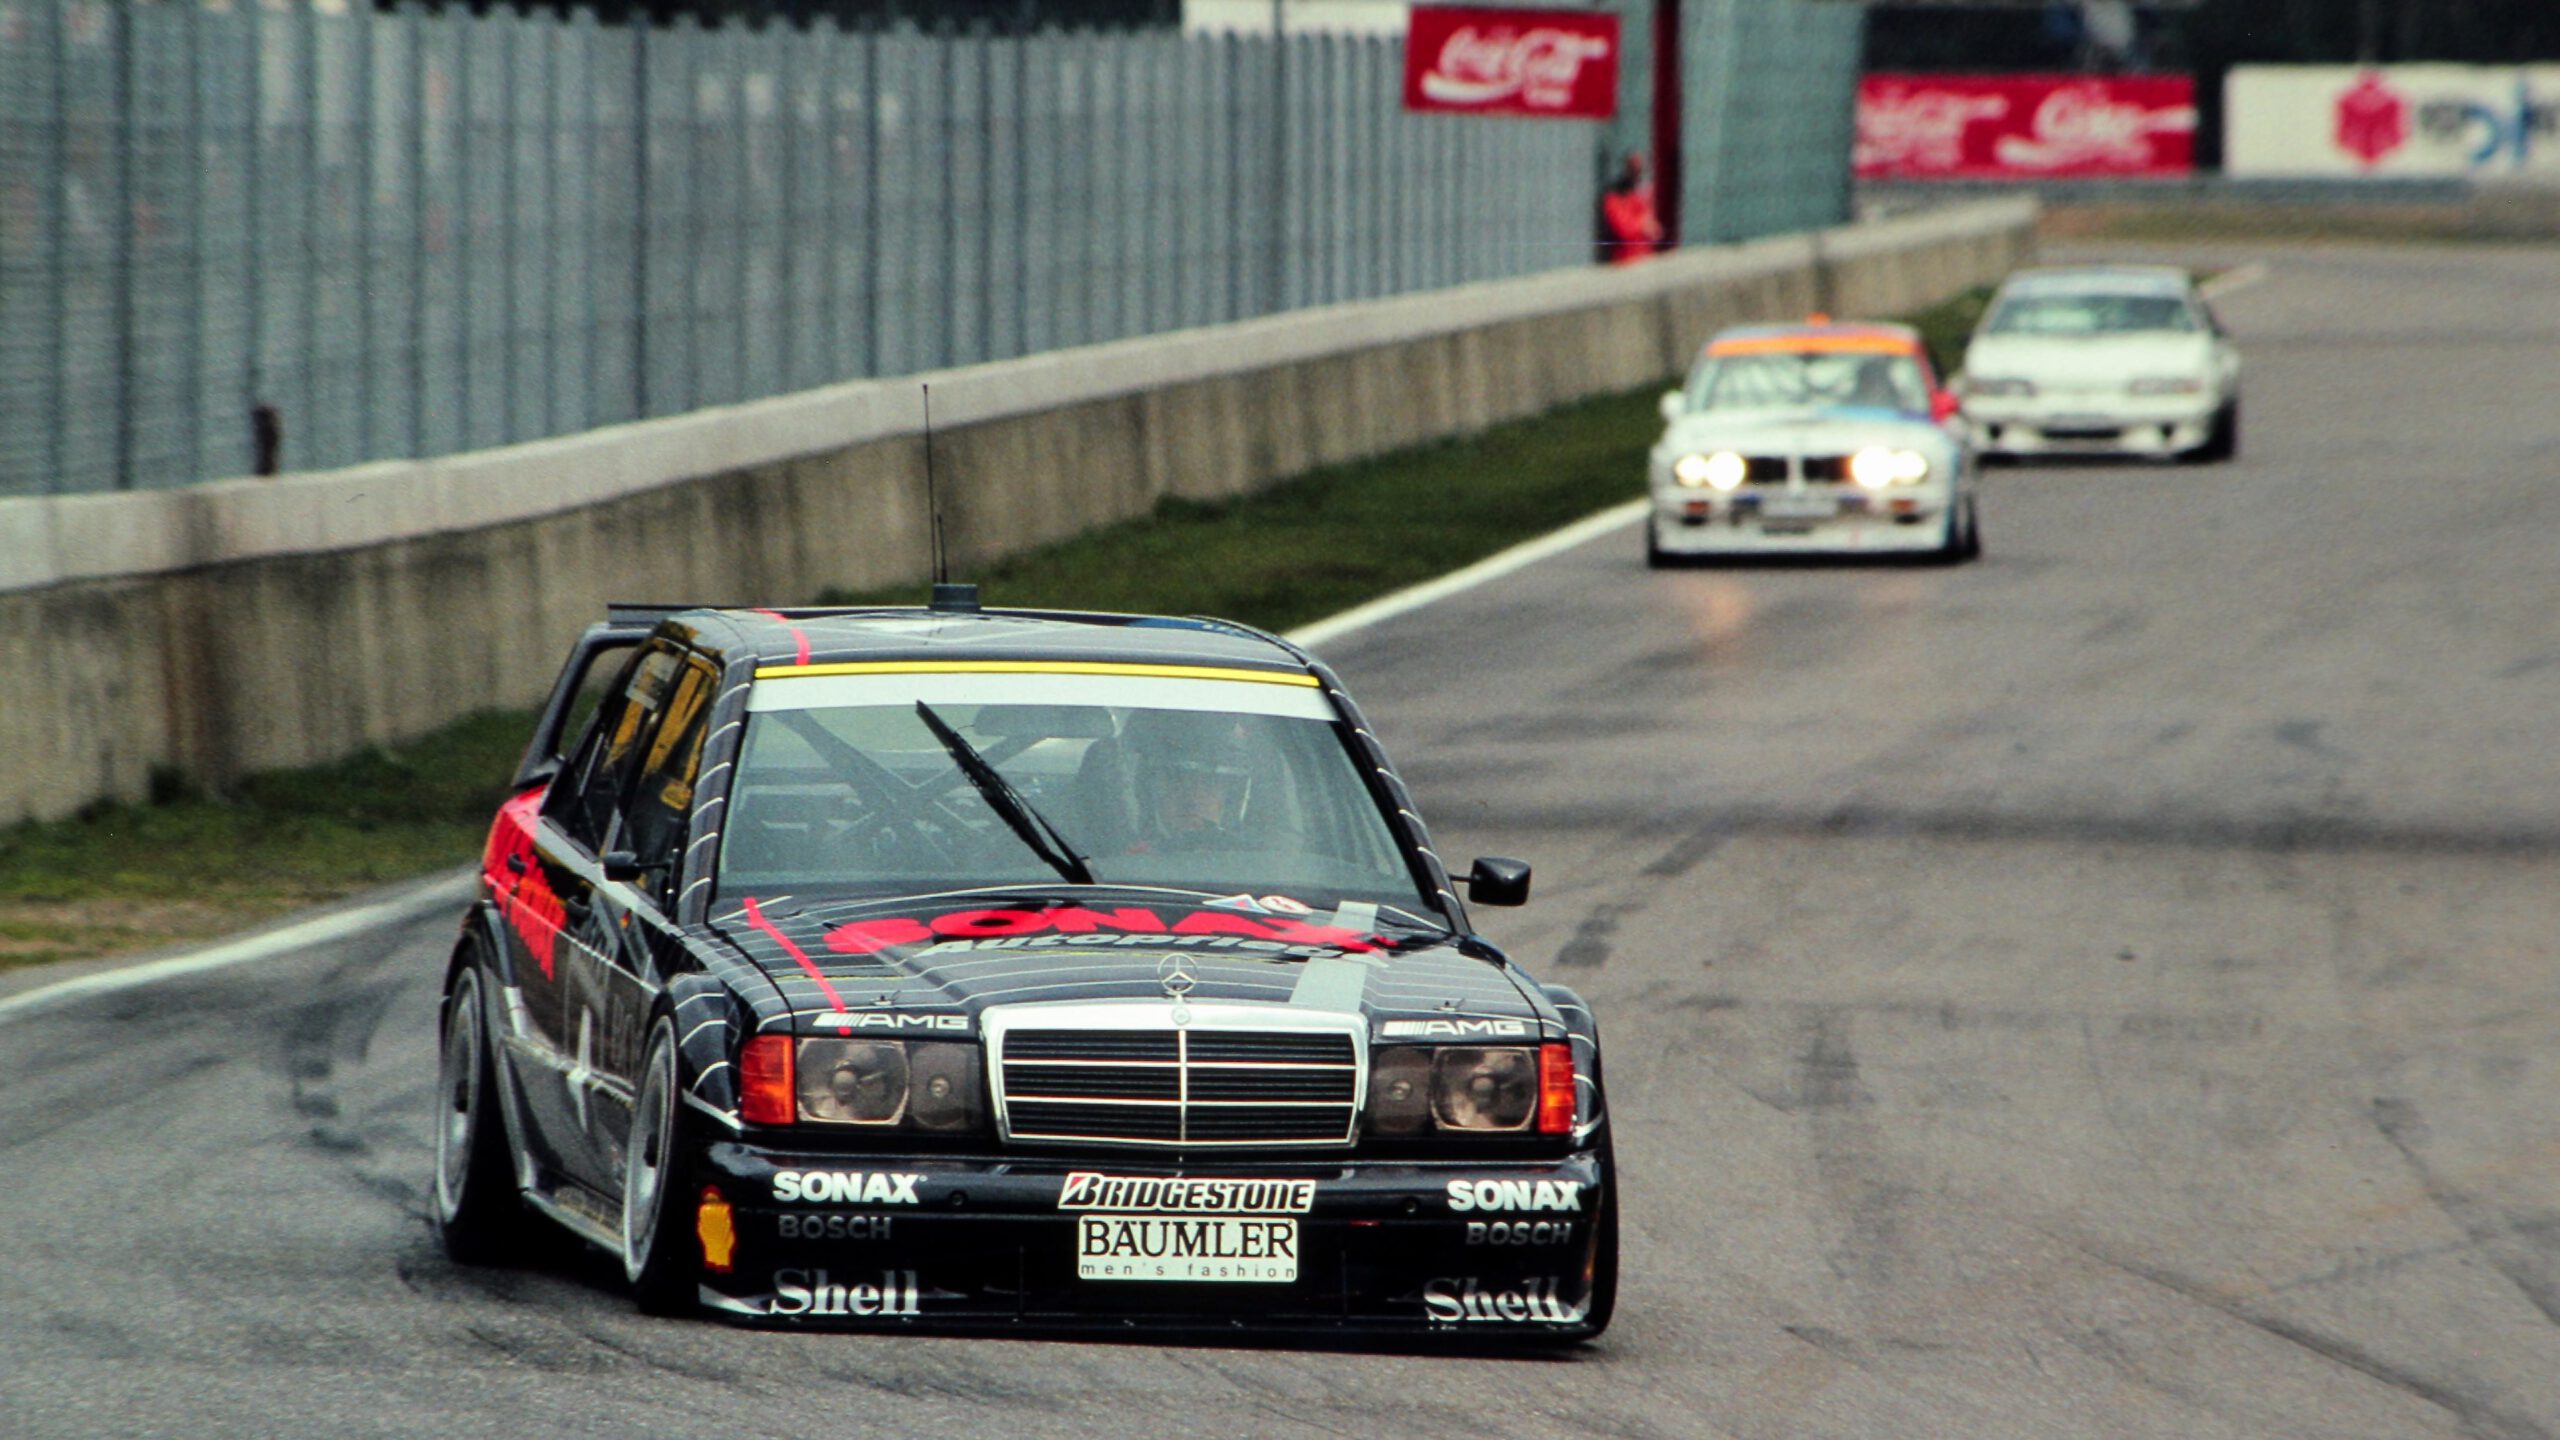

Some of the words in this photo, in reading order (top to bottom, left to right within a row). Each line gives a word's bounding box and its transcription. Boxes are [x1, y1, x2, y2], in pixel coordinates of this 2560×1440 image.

[823, 906, 1400, 953] SONAX
[914, 933, 1388, 968] Autopflege
[858, 1013, 969, 1029] AMG
[1424, 1020, 1526, 1036] AMG
[772, 1170, 920, 1204] SONAX
[1059, 1174, 1311, 1211] BRIDGESTONE
[1447, 1180, 1582, 1212] SONAX
[779, 1214, 892, 1240] BOSCH
[1082, 1219, 1295, 1259] BÄUMLER
[1465, 1221, 1573, 1246] BOSCH
[1080, 1262, 1165, 1276] men's
[1187, 1263, 1295, 1279] fashion
[769, 1268, 921, 1316] Shell
[1423, 1277, 1571, 1322] Shell
